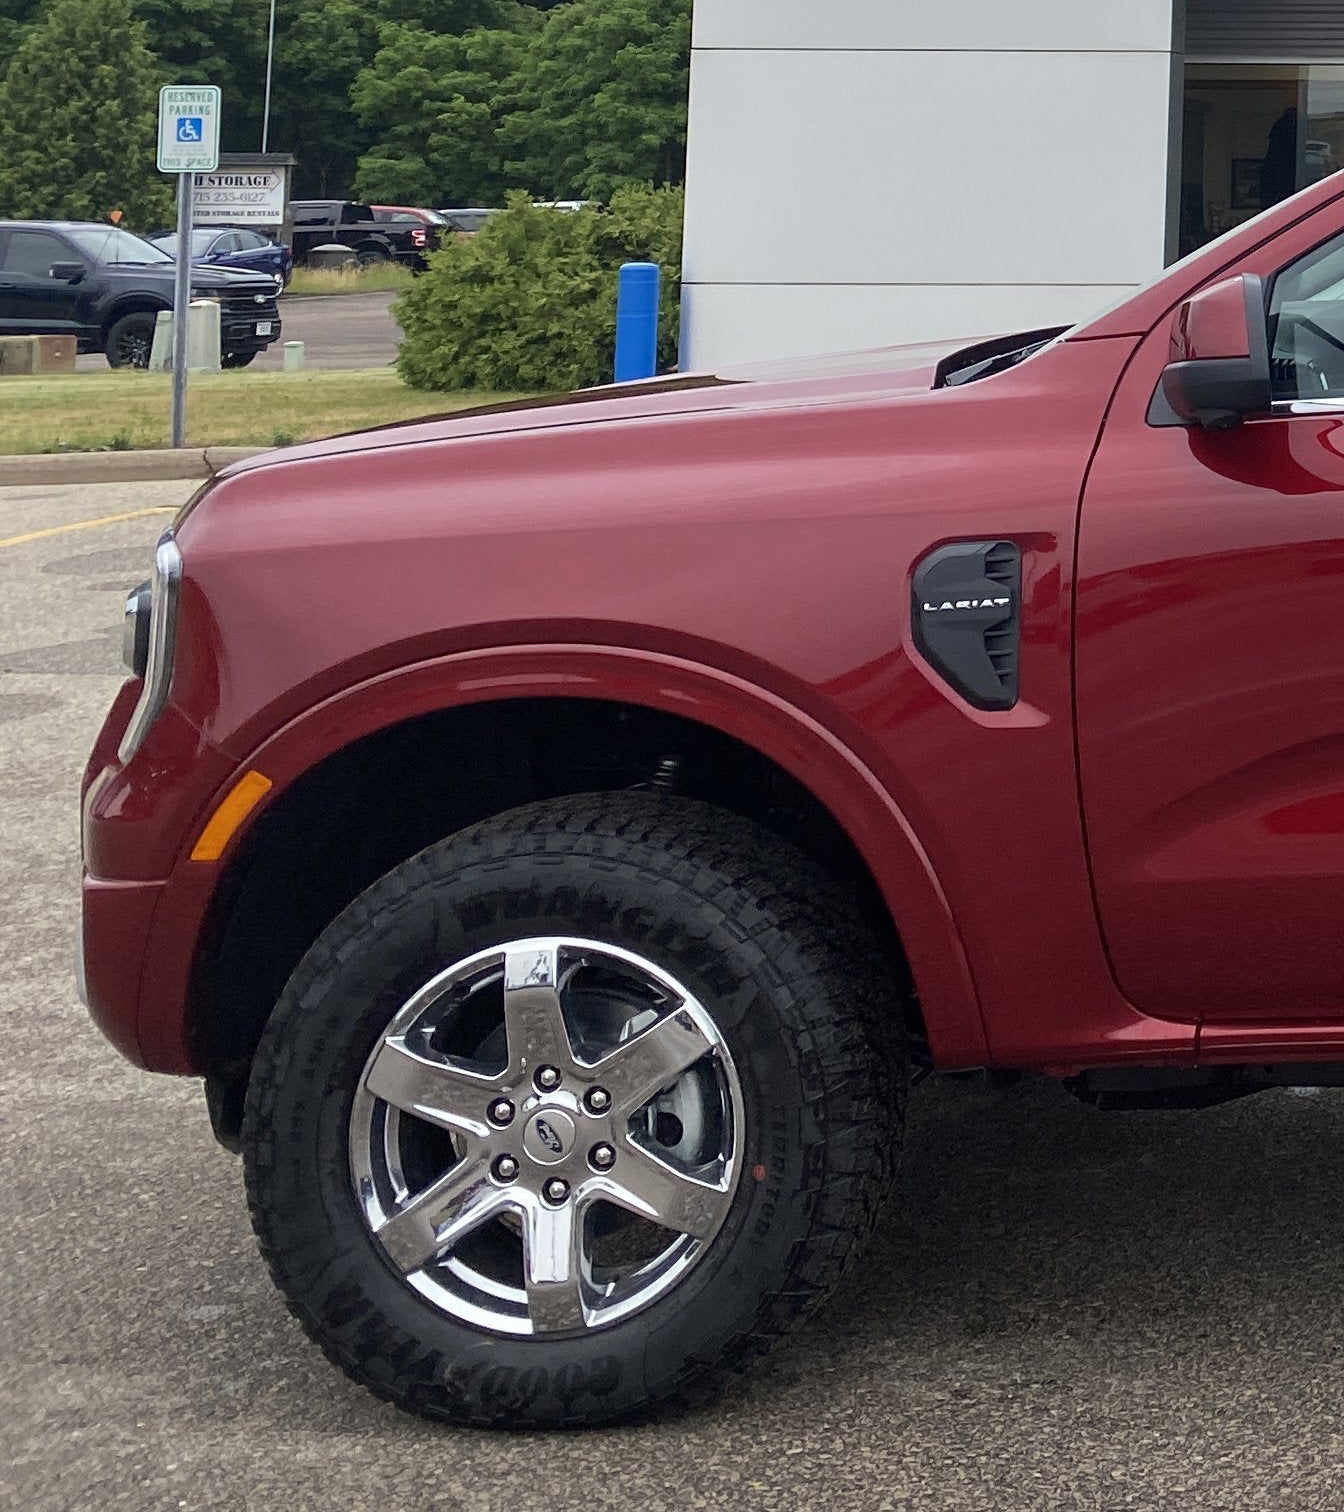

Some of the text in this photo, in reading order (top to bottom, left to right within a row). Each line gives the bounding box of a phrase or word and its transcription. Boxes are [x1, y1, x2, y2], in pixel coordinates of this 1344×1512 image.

[167, 91, 213, 102] RESERVED
[169, 105, 211, 116] PARKING
[163, 158, 212, 167] THIS SPACE
[207, 175, 270, 186] STORAGE
[923, 597, 1010, 612] LARIAT
